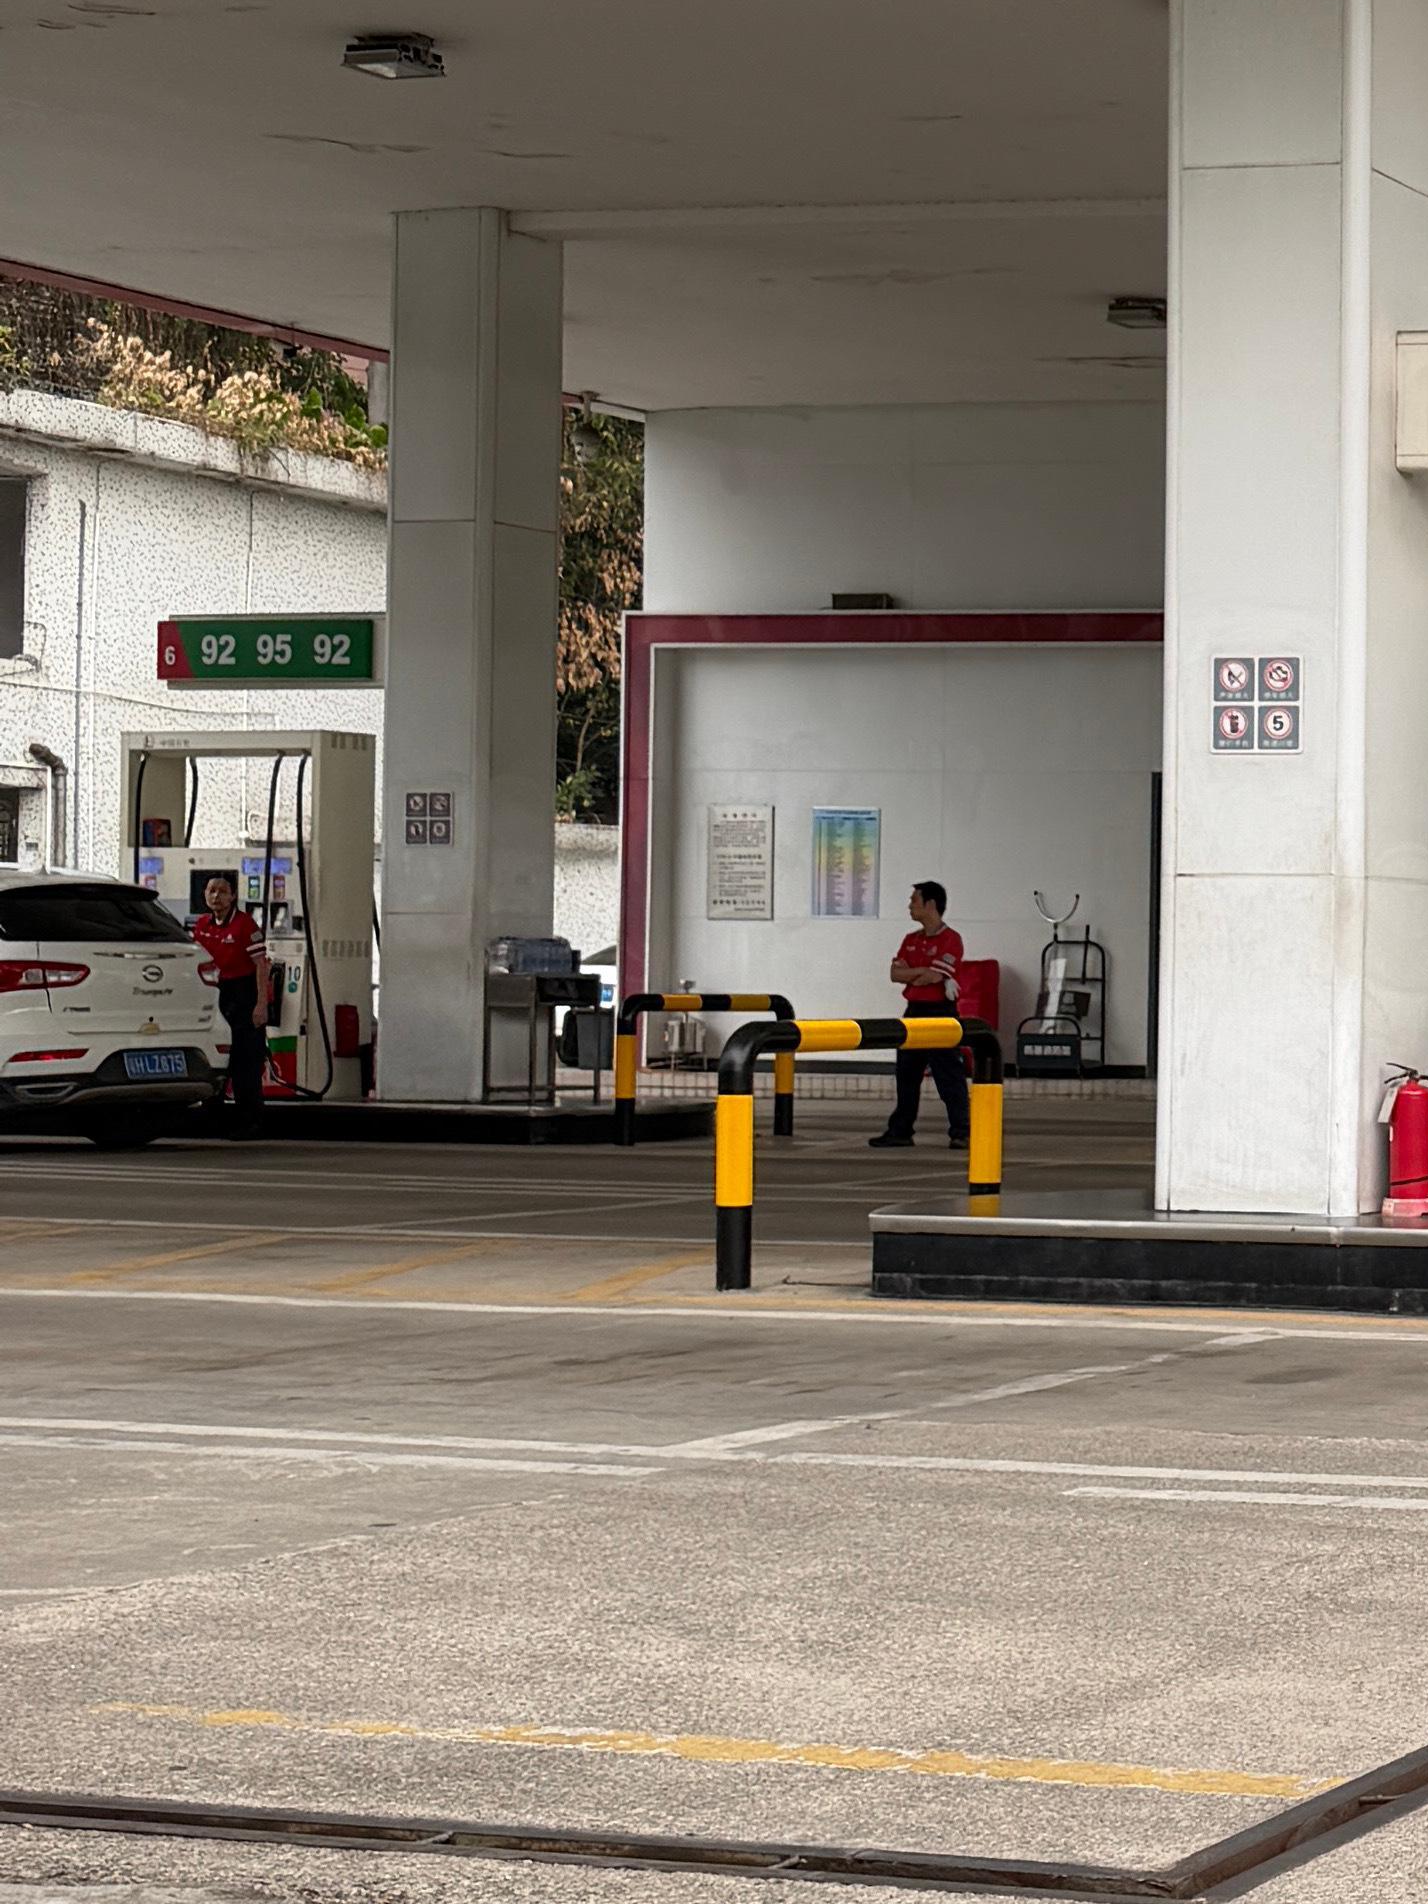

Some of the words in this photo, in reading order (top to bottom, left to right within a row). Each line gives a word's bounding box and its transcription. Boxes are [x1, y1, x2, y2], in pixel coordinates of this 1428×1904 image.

[164, 646, 176, 665] 6
[201, 635, 236, 665] 92
[257, 634, 292, 664] 95
[313, 634, 351, 664] 92
[1273, 715, 1284, 731] 5
[288, 965, 301, 981] 10
